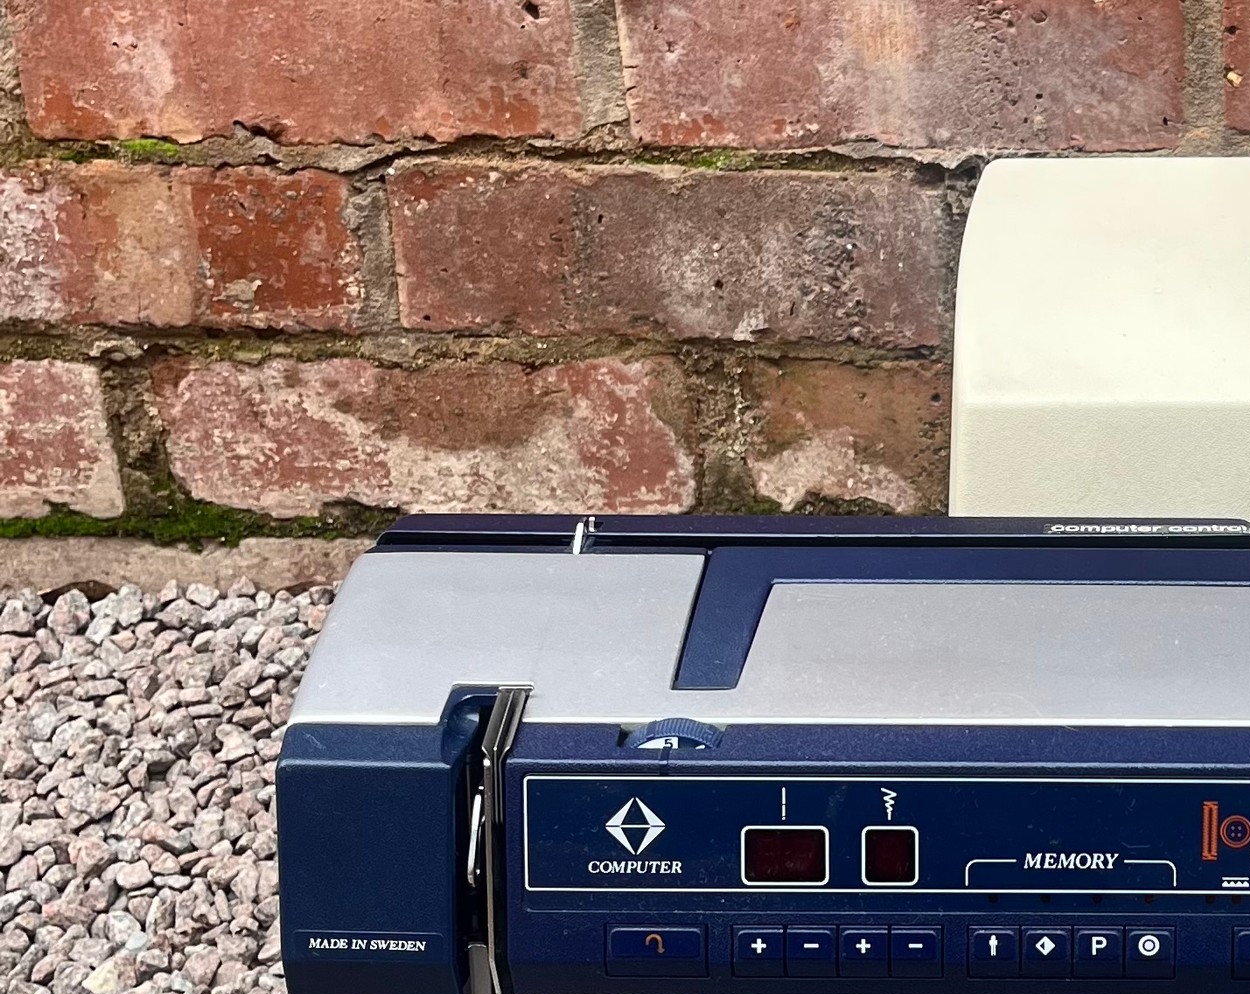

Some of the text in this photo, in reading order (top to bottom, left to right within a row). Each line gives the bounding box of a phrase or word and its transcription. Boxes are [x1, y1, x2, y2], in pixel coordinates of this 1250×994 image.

[1050, 524, 1161, 535] computer
[588, 861, 681, 873] COMPUTER
[1024, 853, 1118, 868] MEMORY
[309, 938, 426, 951] MADE IN SWEDEN
[1092, 937, 1107, 955] P
